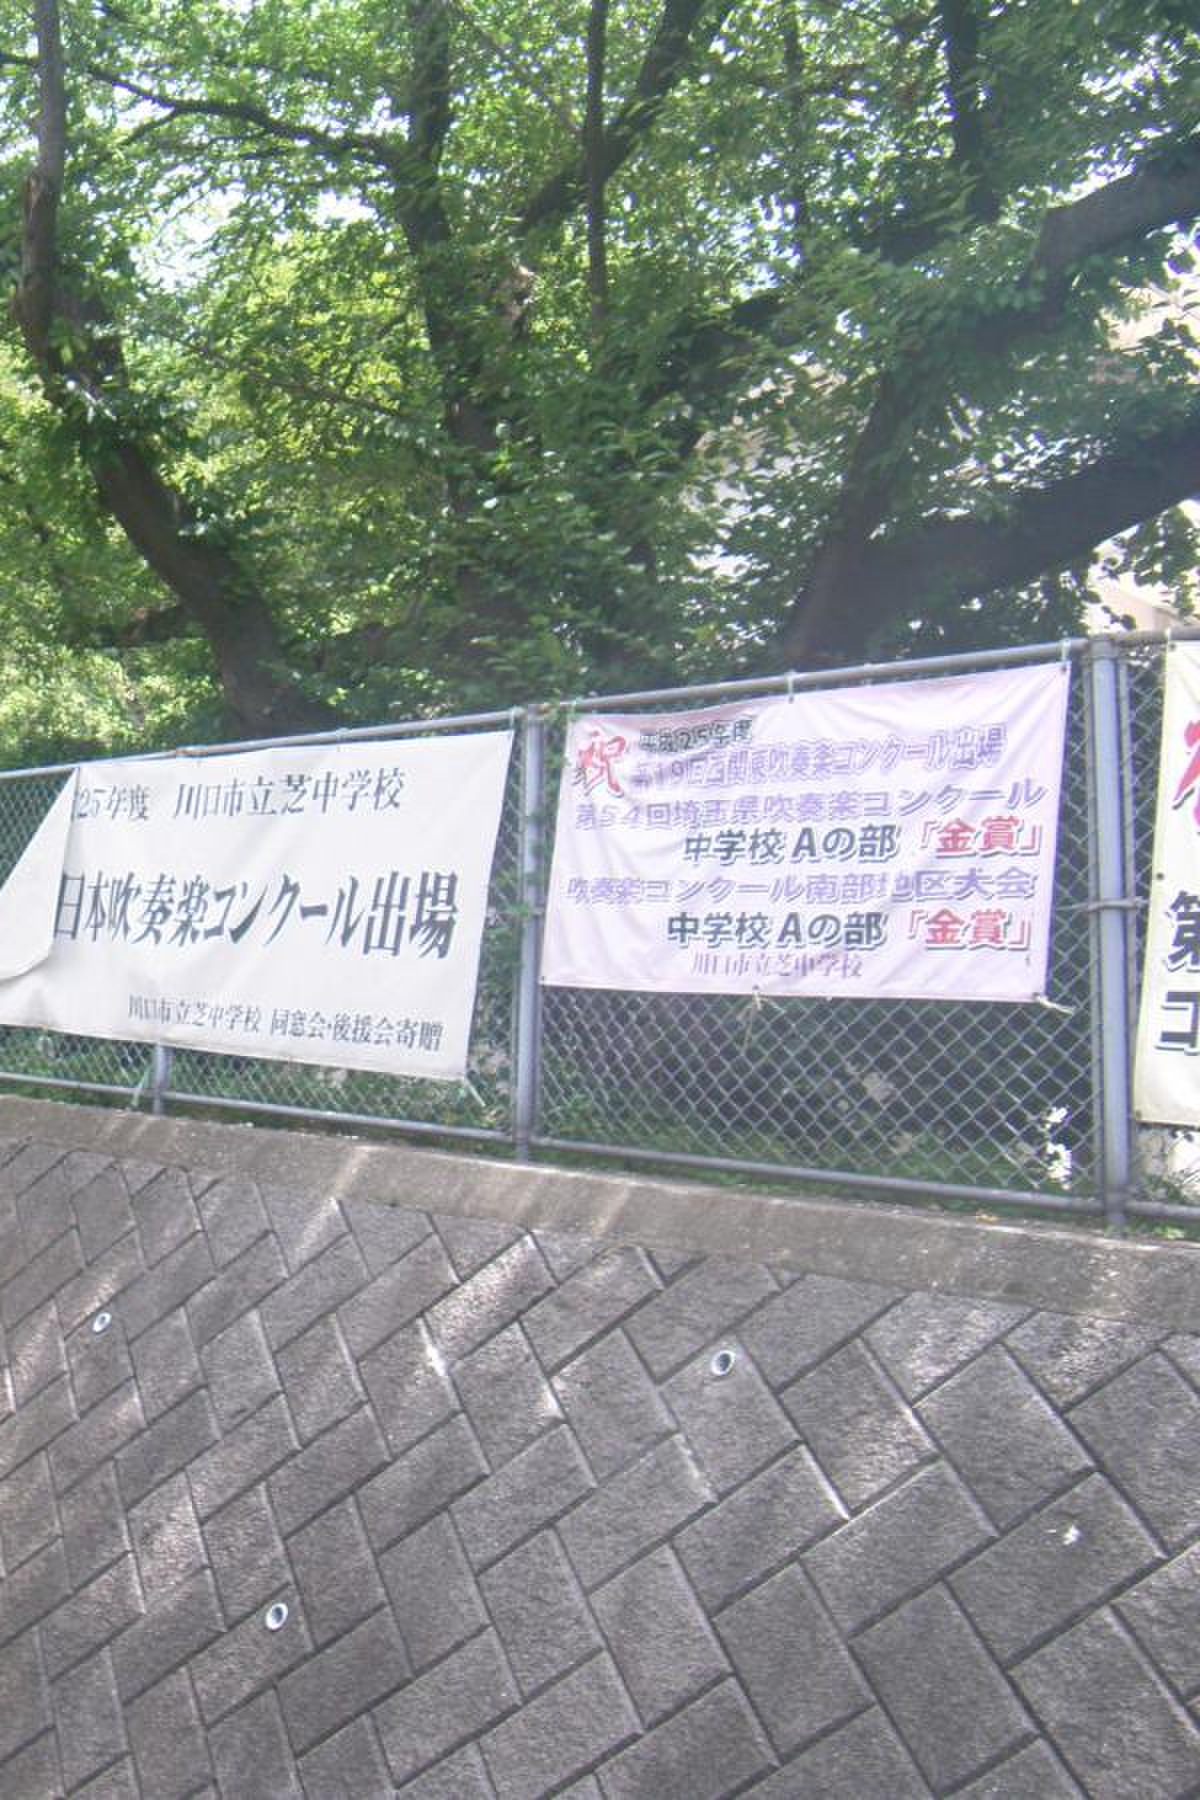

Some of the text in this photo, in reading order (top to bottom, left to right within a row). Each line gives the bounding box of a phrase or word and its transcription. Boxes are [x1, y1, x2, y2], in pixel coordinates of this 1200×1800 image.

[174, 767, 406, 822] 川口市立芝中学校
[54, 870, 460, 959] 日本吹奏楽コンクール出場
